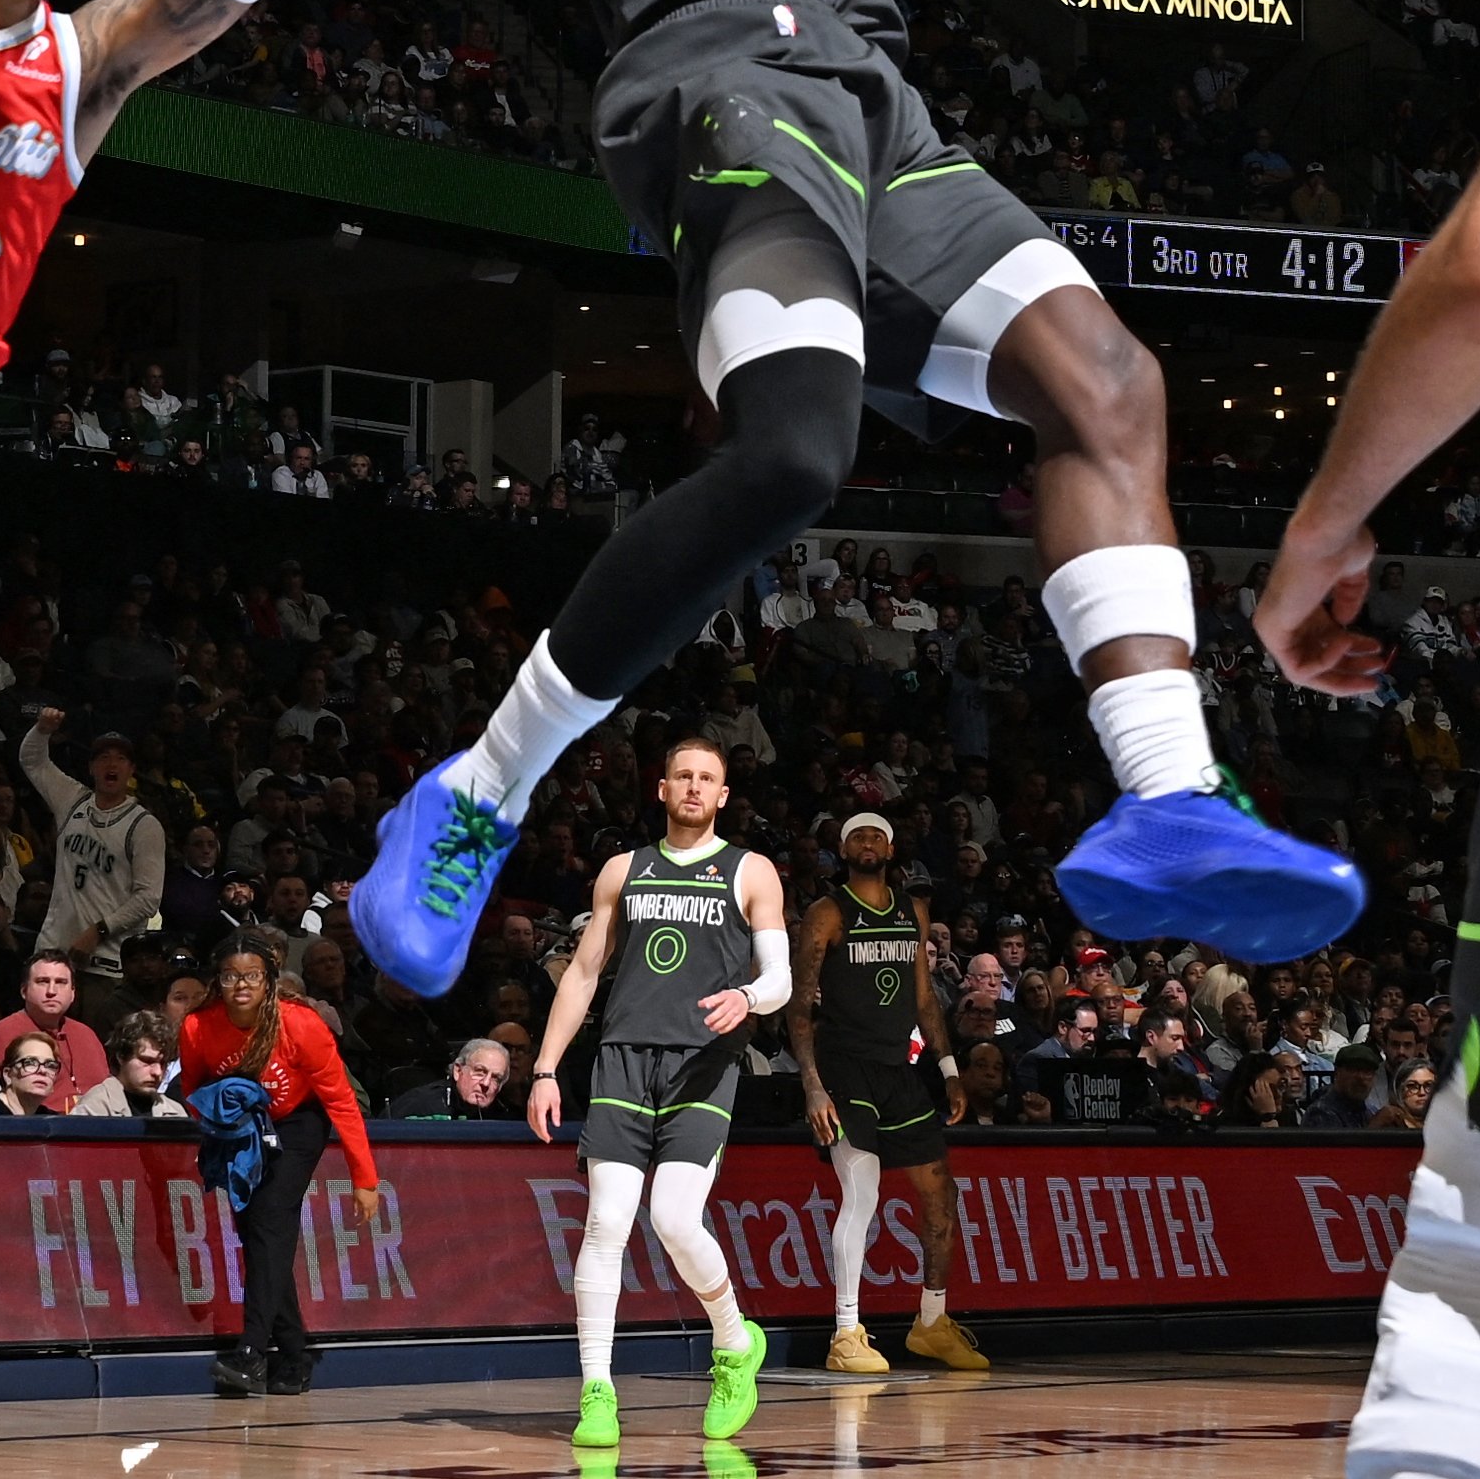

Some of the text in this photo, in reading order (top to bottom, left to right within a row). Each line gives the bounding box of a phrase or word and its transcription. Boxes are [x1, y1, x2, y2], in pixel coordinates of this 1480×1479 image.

[1051, 221, 1118, 249] TS: 4
[1152, 236, 1198, 276] 3RD
[1281, 238, 1366, 292] 4:12
[64, 834, 115, 874] WOLVES
[74, 864, 89, 890] 5
[625, 893, 727, 927] TIMBERWOLVES
[644, 926, 688, 974] 0
[847, 940, 920, 966] TIMBERWOLVE
[874, 966, 901, 1006] 9
[1083, 1074, 1121, 1101] Replay
[1083, 1096, 1121, 1120] Center
[27, 1179, 140, 1309] FLY
[166, 1179, 417, 1306] BETER
[952, 1176, 1039, 1284] FLY
[1045, 1176, 1230, 1283] BETTER
